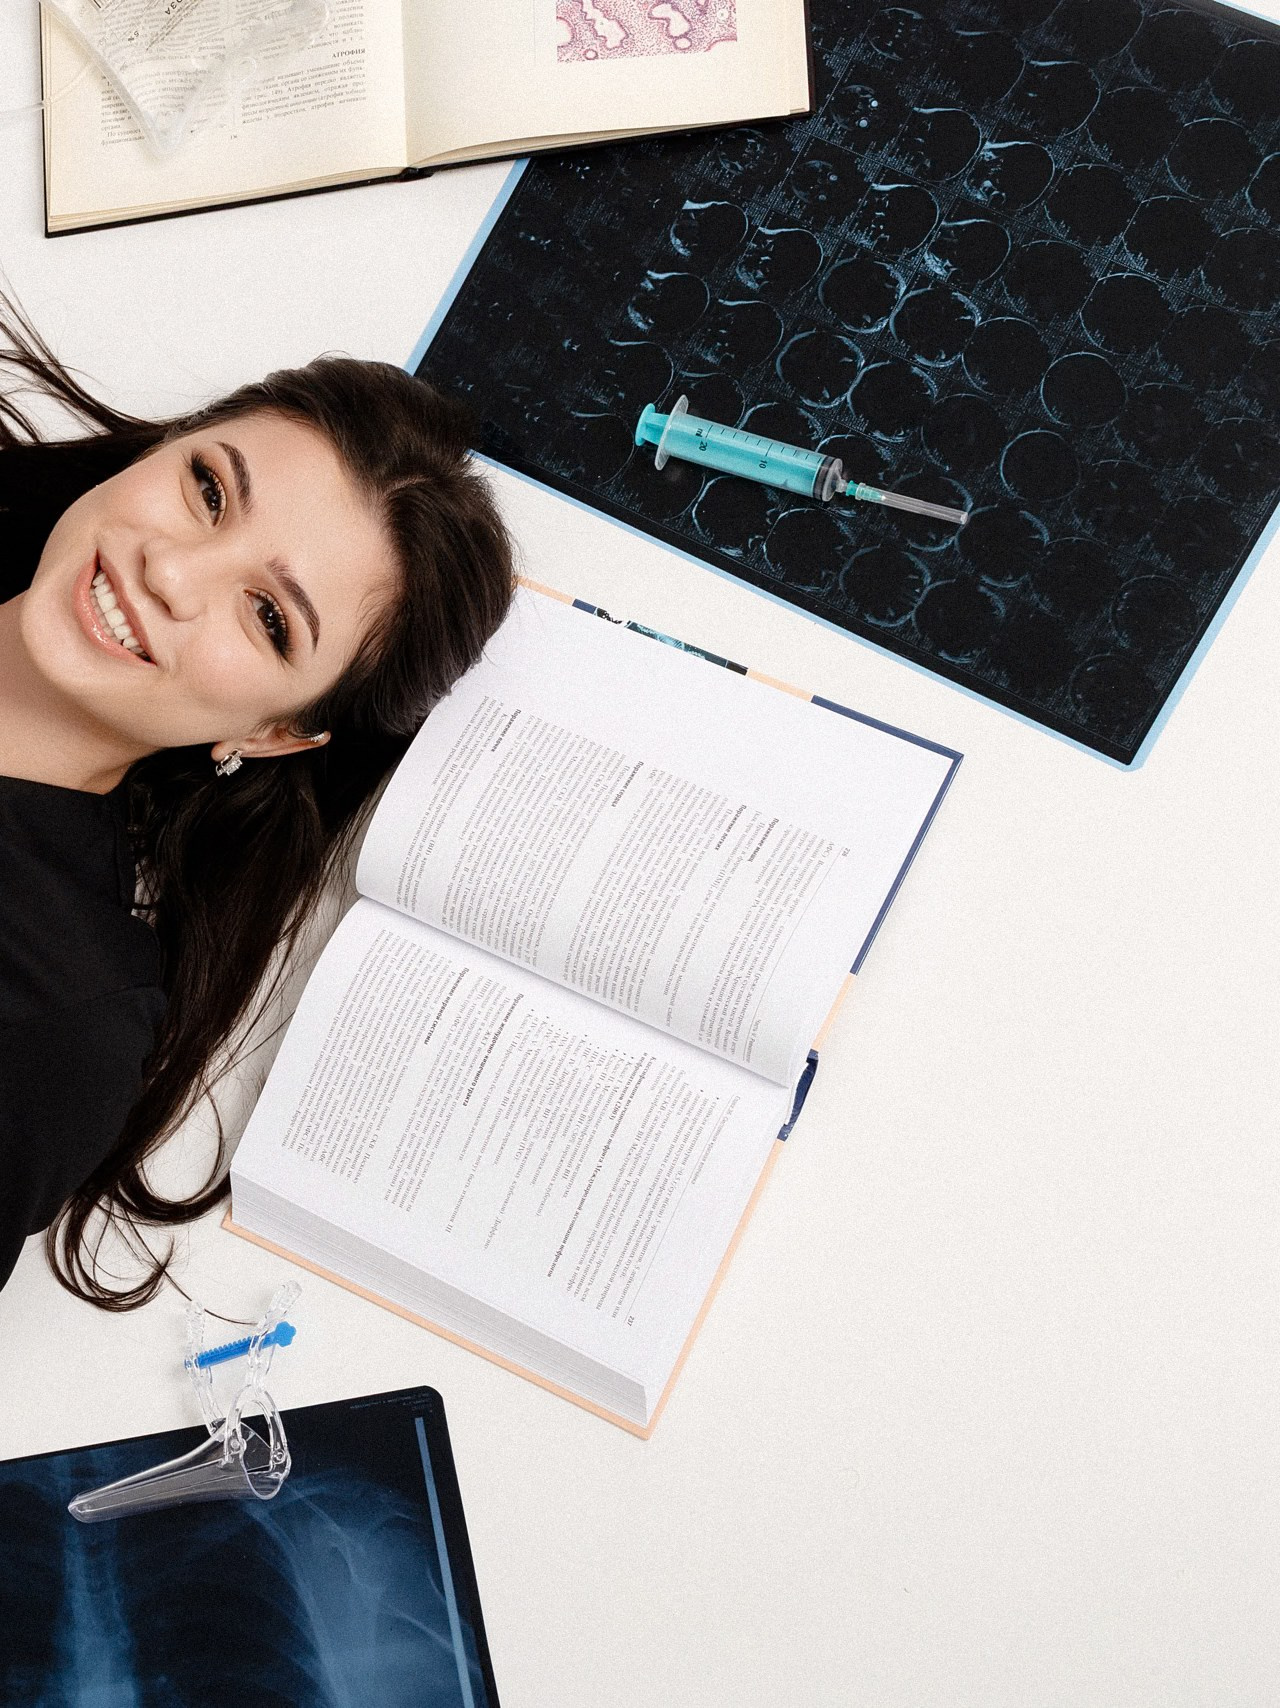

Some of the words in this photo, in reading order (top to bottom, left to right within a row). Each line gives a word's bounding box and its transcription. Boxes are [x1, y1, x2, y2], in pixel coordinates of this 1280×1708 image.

[331, 47, 365, 59] АТРОФИЯ
[699, 440, 707, 452] 20
[759, 459, 768, 469] 10
[499, 708, 521, 737] Поражение
[490, 736, 503, 753] почек
[621, 760, 643, 789] Поражение
[610, 788, 625, 807] сердца
[724, 804, 746, 833] Поражение
[713, 832, 728, 851] легких
[757, 817, 779, 847] Поражение
[747, 846, 761, 863] мышц
[447, 966, 469, 997] Поражение
[434, 995, 451, 1021] нервной
[501, 992, 524, 1022] Поражение
[422, 1019, 439, 1045] системы
[470, 1022, 506, 1086] желудочно-кишечного
[461, 1086, 475, 1107] тракта
[608, 1100, 622, 1120] (2003)
[626, 1315, 634, 1326] 237
